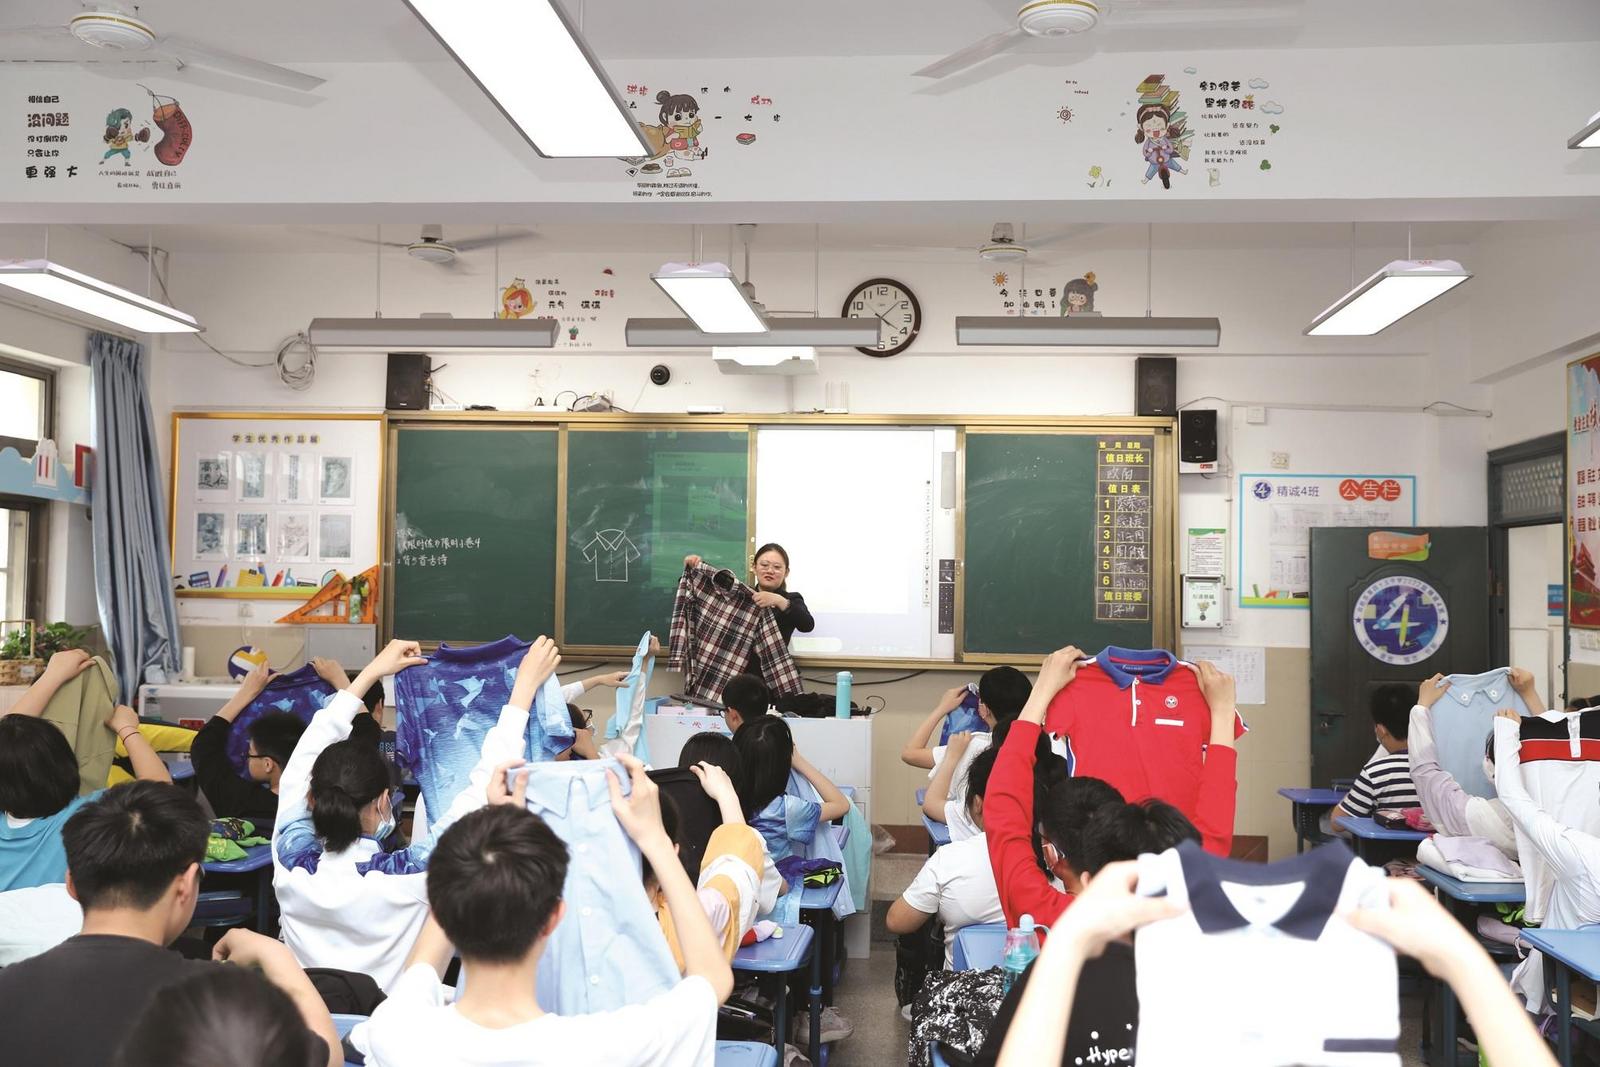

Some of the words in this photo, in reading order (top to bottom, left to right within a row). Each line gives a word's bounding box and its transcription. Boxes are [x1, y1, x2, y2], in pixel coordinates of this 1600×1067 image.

[27, 112, 69, 127] 没问题
[877, 286, 888, 296] 12
[853, 301, 864, 311] 10
[901, 300, 909, 310] 2
[903, 313, 912, 323] 3
[900, 326, 908, 335] 4
[890, 336, 898, 346] 5
[1106, 453, 1144, 463] 值日班长
[1108, 484, 1141, 494] 值日表
[1277, 486, 1319, 497] 精诚4班
[1342, 481, 1400, 498] 公告栏
[1104, 499, 1110, 509] 1
[1103, 514, 1111, 525] 2
[1103, 529, 1110, 540] 3
[1103, 545, 1110, 555] 4
[1103, 560, 1110, 570] 5
[1103, 575, 1110, 586] 6
[1086, 1045, 1131, 1066] Hype
